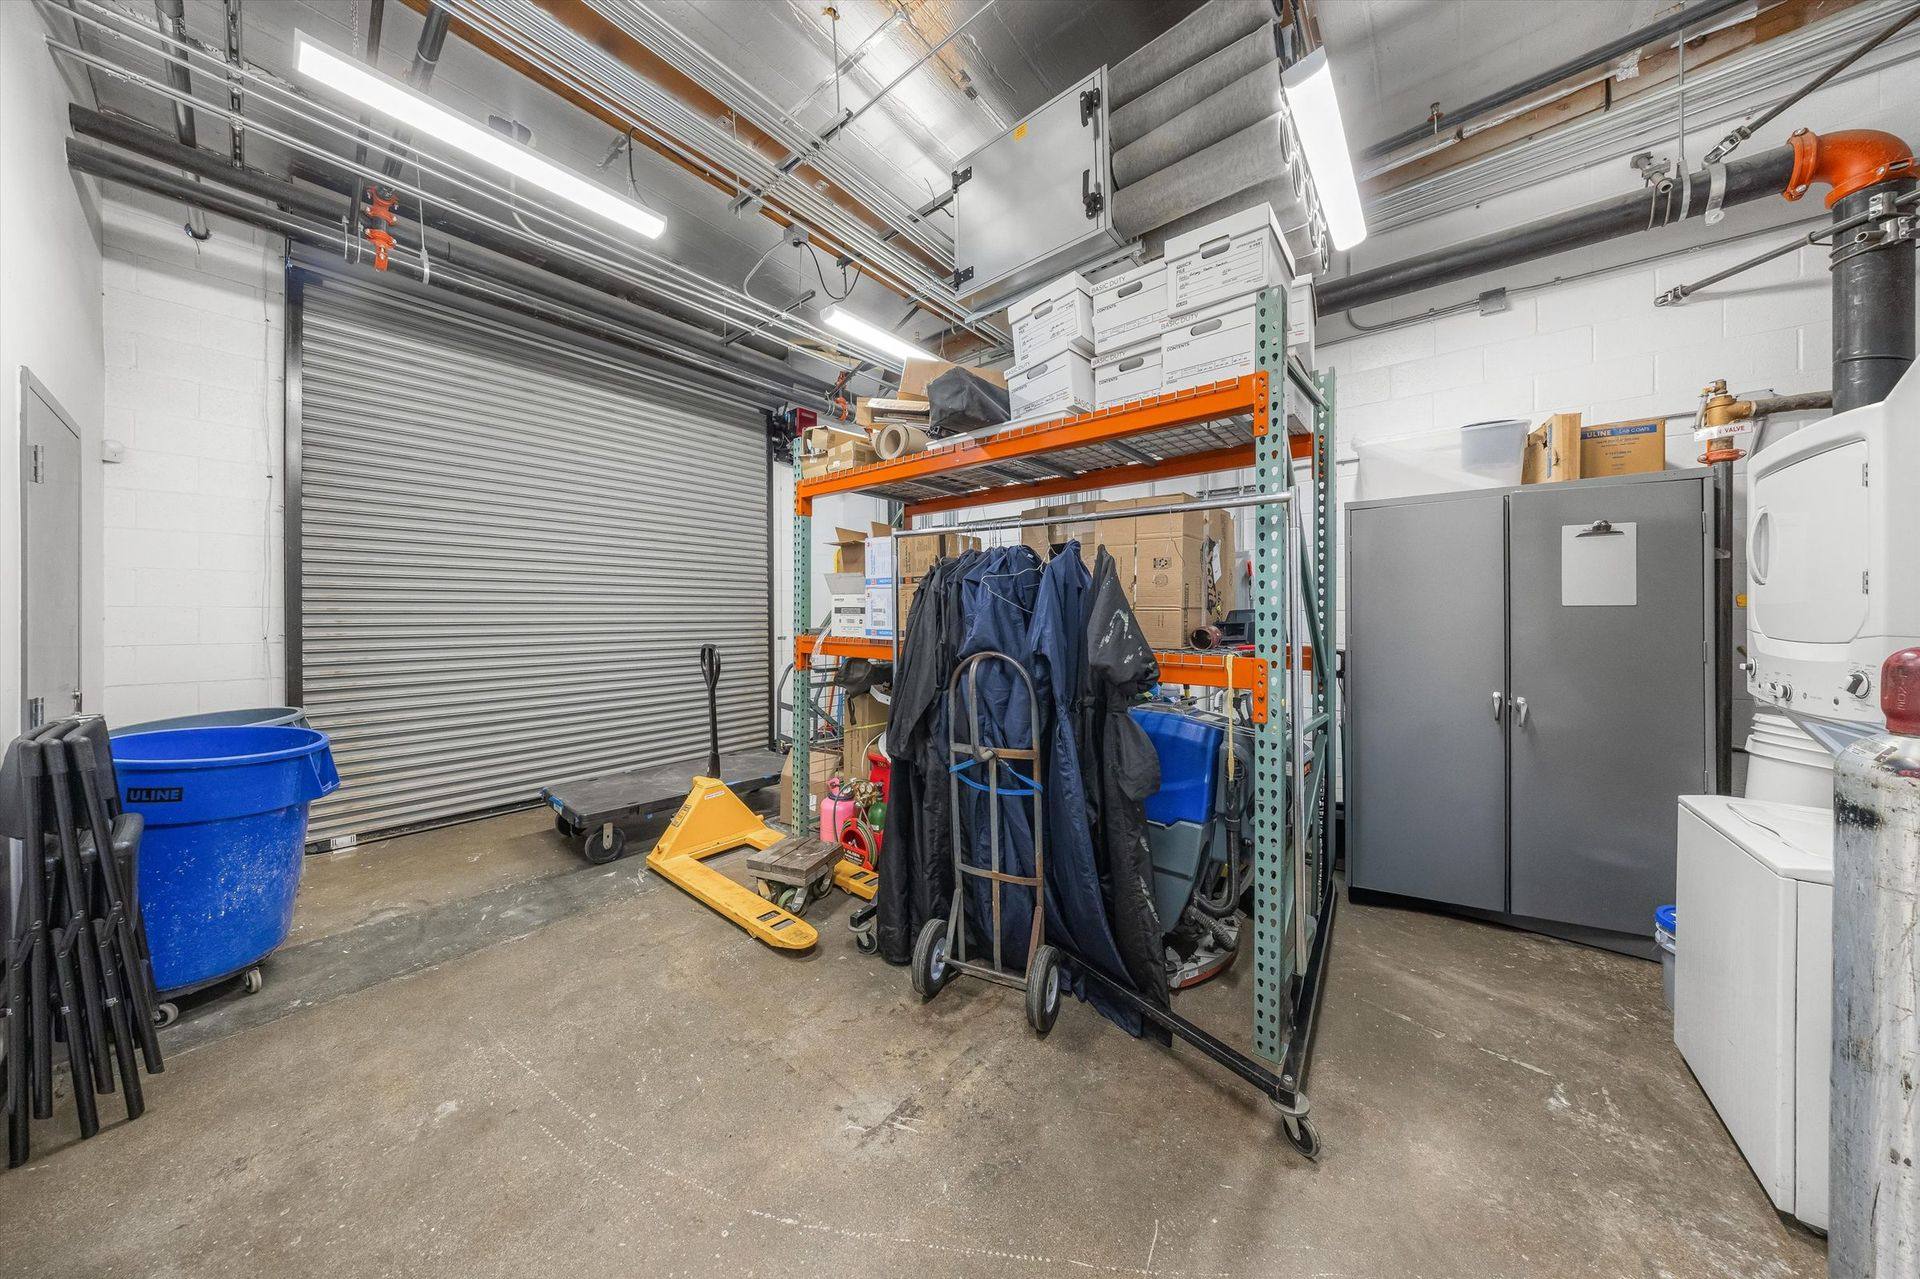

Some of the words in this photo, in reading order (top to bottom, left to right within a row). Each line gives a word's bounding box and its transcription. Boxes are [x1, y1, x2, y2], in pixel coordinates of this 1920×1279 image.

[1091, 282, 1109, 294] BASIC
[1110, 275, 1126, 287] DUTY
[1181, 312, 1200, 325] DUTY
[1166, 341, 1190, 352] CONTENTS
[1586, 429, 1611, 438] ULINE
[1631, 425, 1650, 433] COATS
[1724, 425, 1745, 433] VALVE
[129, 789, 180, 801] ULINE
